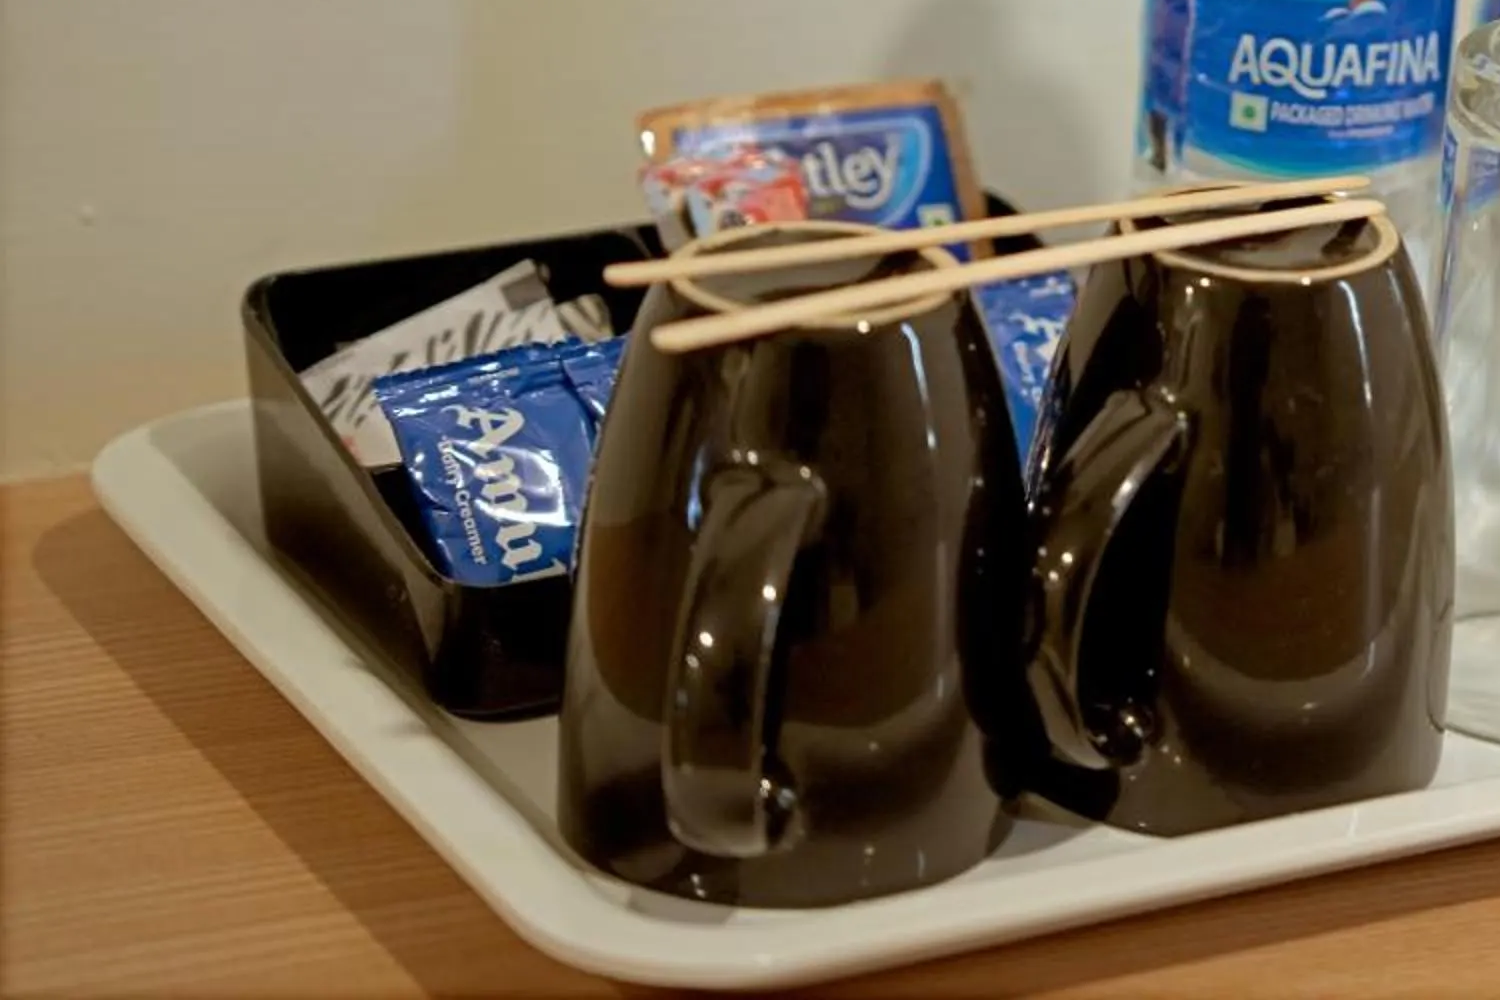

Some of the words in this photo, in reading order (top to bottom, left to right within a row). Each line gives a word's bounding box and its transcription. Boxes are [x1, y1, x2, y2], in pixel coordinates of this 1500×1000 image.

[1228, 31, 1440, 99] AQUAFINA
[803, 132, 899, 210] tley
[455, 489, 489, 566] Creamer
